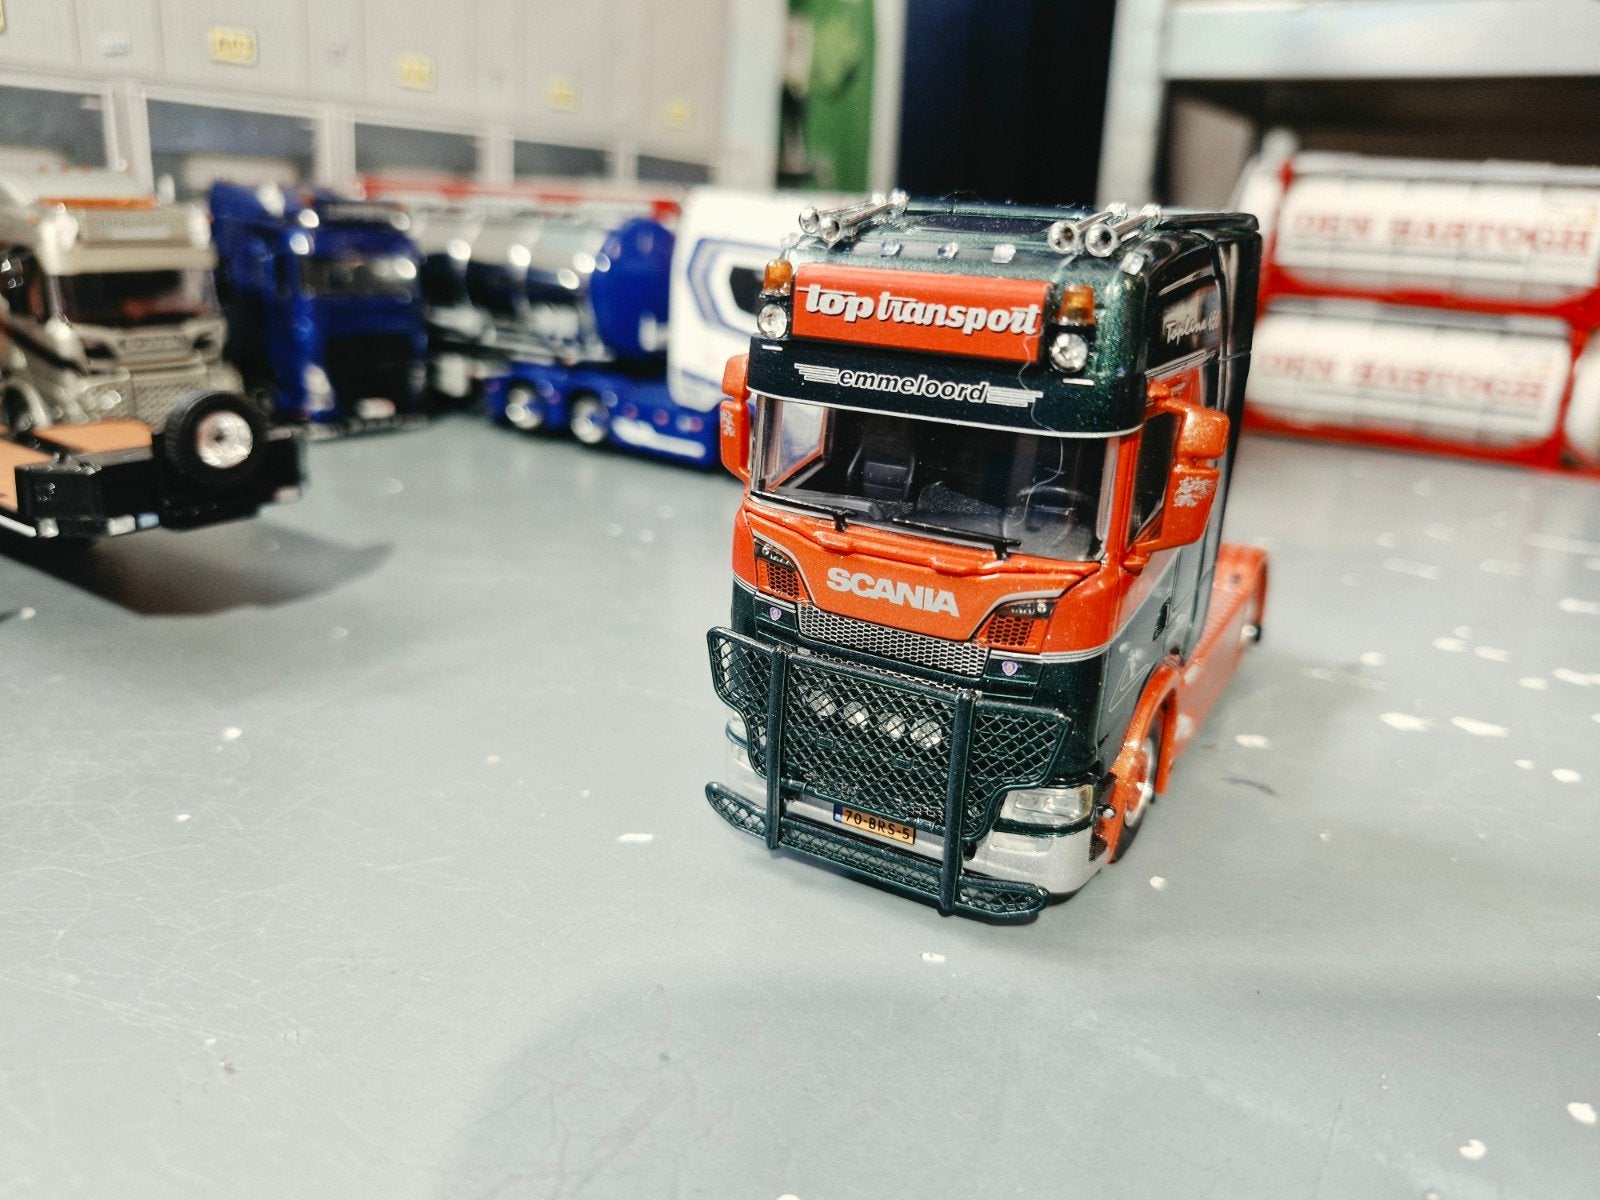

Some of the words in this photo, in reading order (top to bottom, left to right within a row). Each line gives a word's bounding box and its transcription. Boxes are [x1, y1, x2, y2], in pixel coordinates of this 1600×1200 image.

[838, 369, 989, 404] emmeloord
[826, 567, 960, 618] SCANIA
[845, 810, 910, 840] 70-BRS-5
